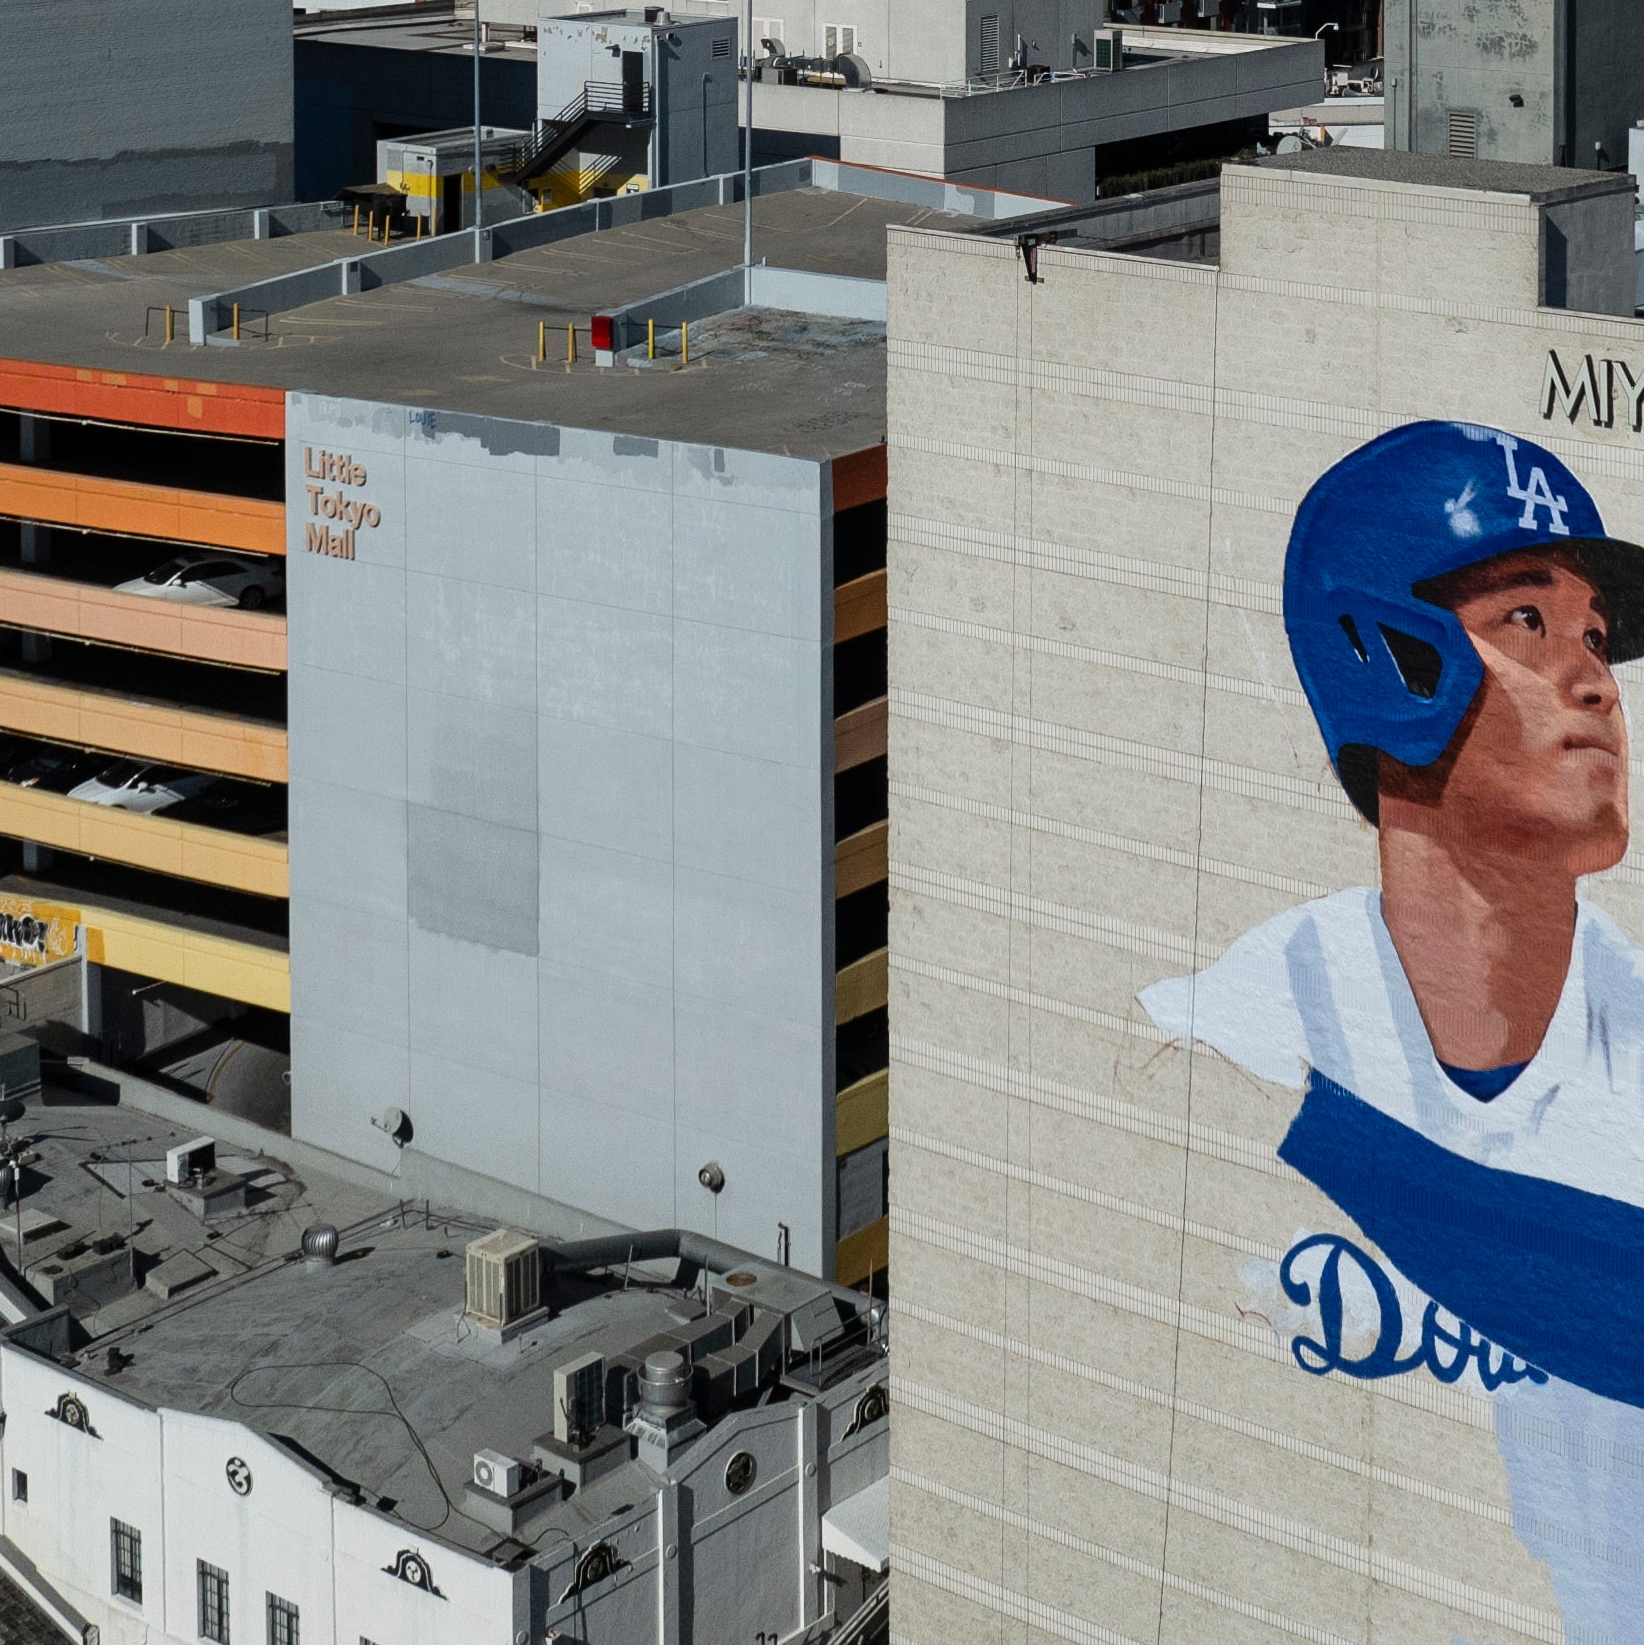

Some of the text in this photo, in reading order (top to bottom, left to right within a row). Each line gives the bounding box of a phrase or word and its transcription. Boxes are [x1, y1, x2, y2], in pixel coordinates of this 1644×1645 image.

[304, 446, 367, 488] Little
[1497, 434, 1571, 536] LA
[306, 486, 381, 532] Tokyo
[306, 522, 357, 561] Mall
